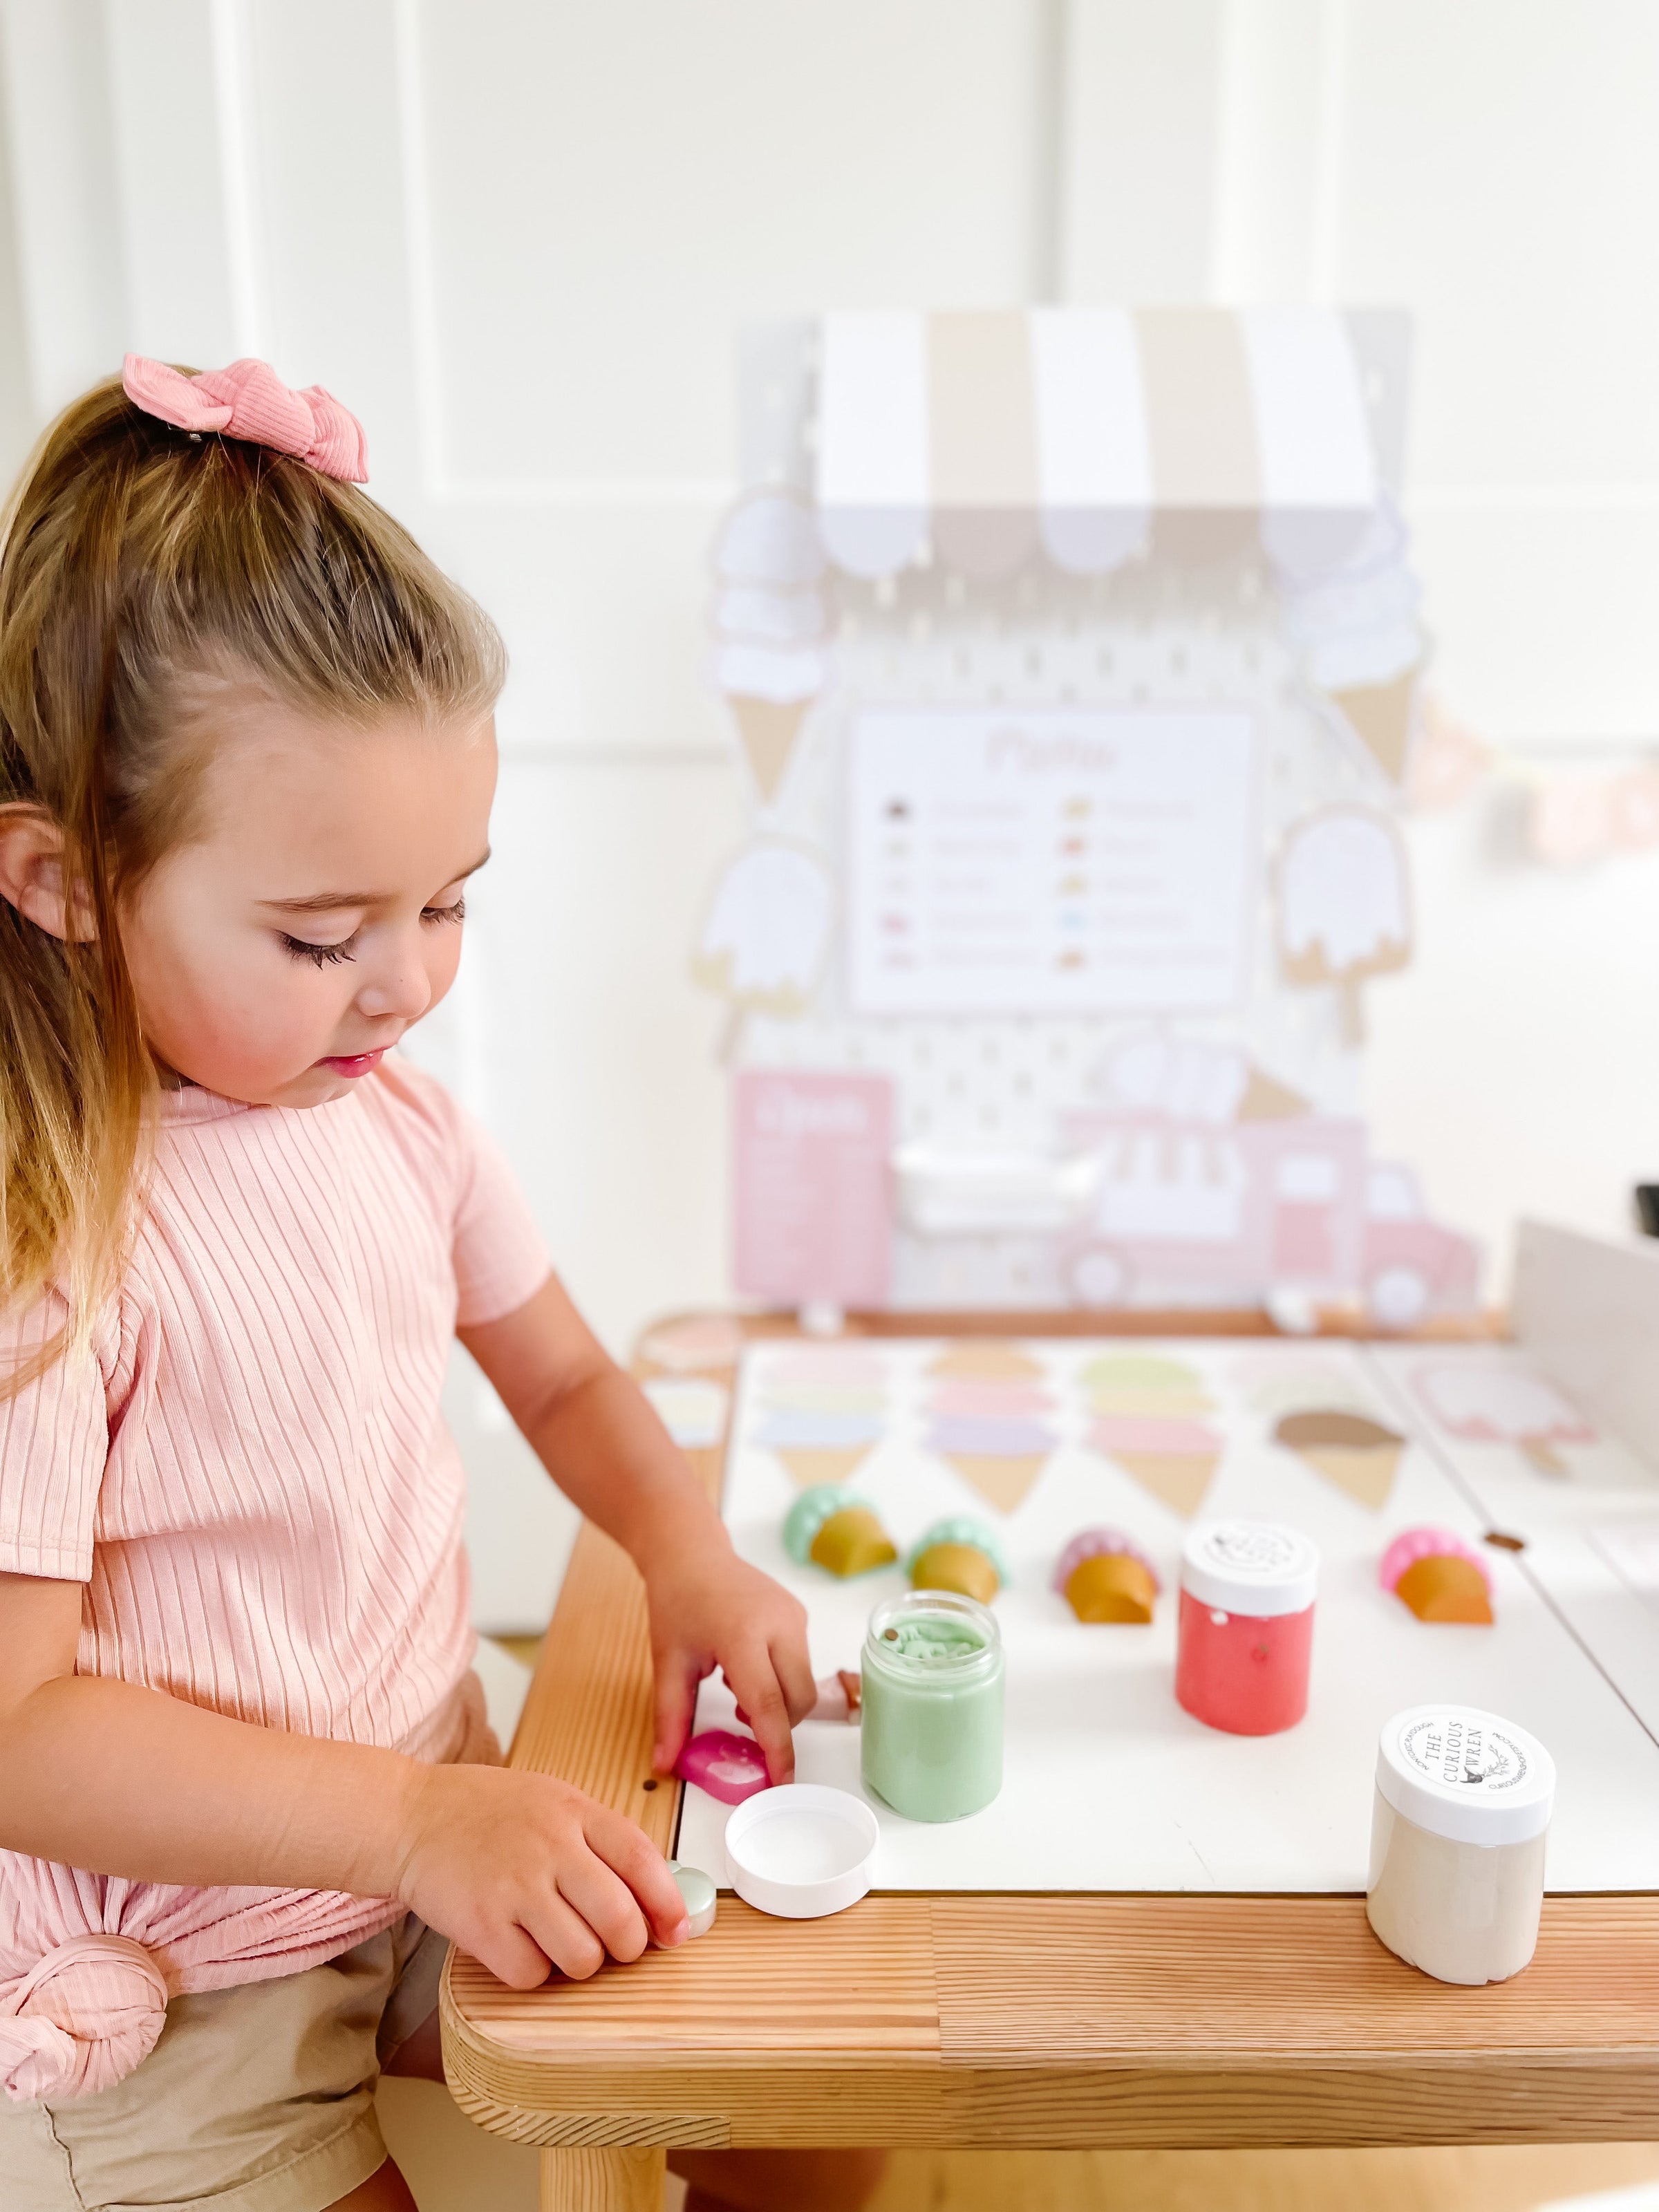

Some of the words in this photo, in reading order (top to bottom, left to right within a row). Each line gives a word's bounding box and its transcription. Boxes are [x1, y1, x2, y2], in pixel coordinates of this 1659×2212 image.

[1425, 1734, 1441, 1760] THE
[1443, 1721, 1463, 1782] CURIOUS
[1465, 1728, 1482, 1765] WREN
